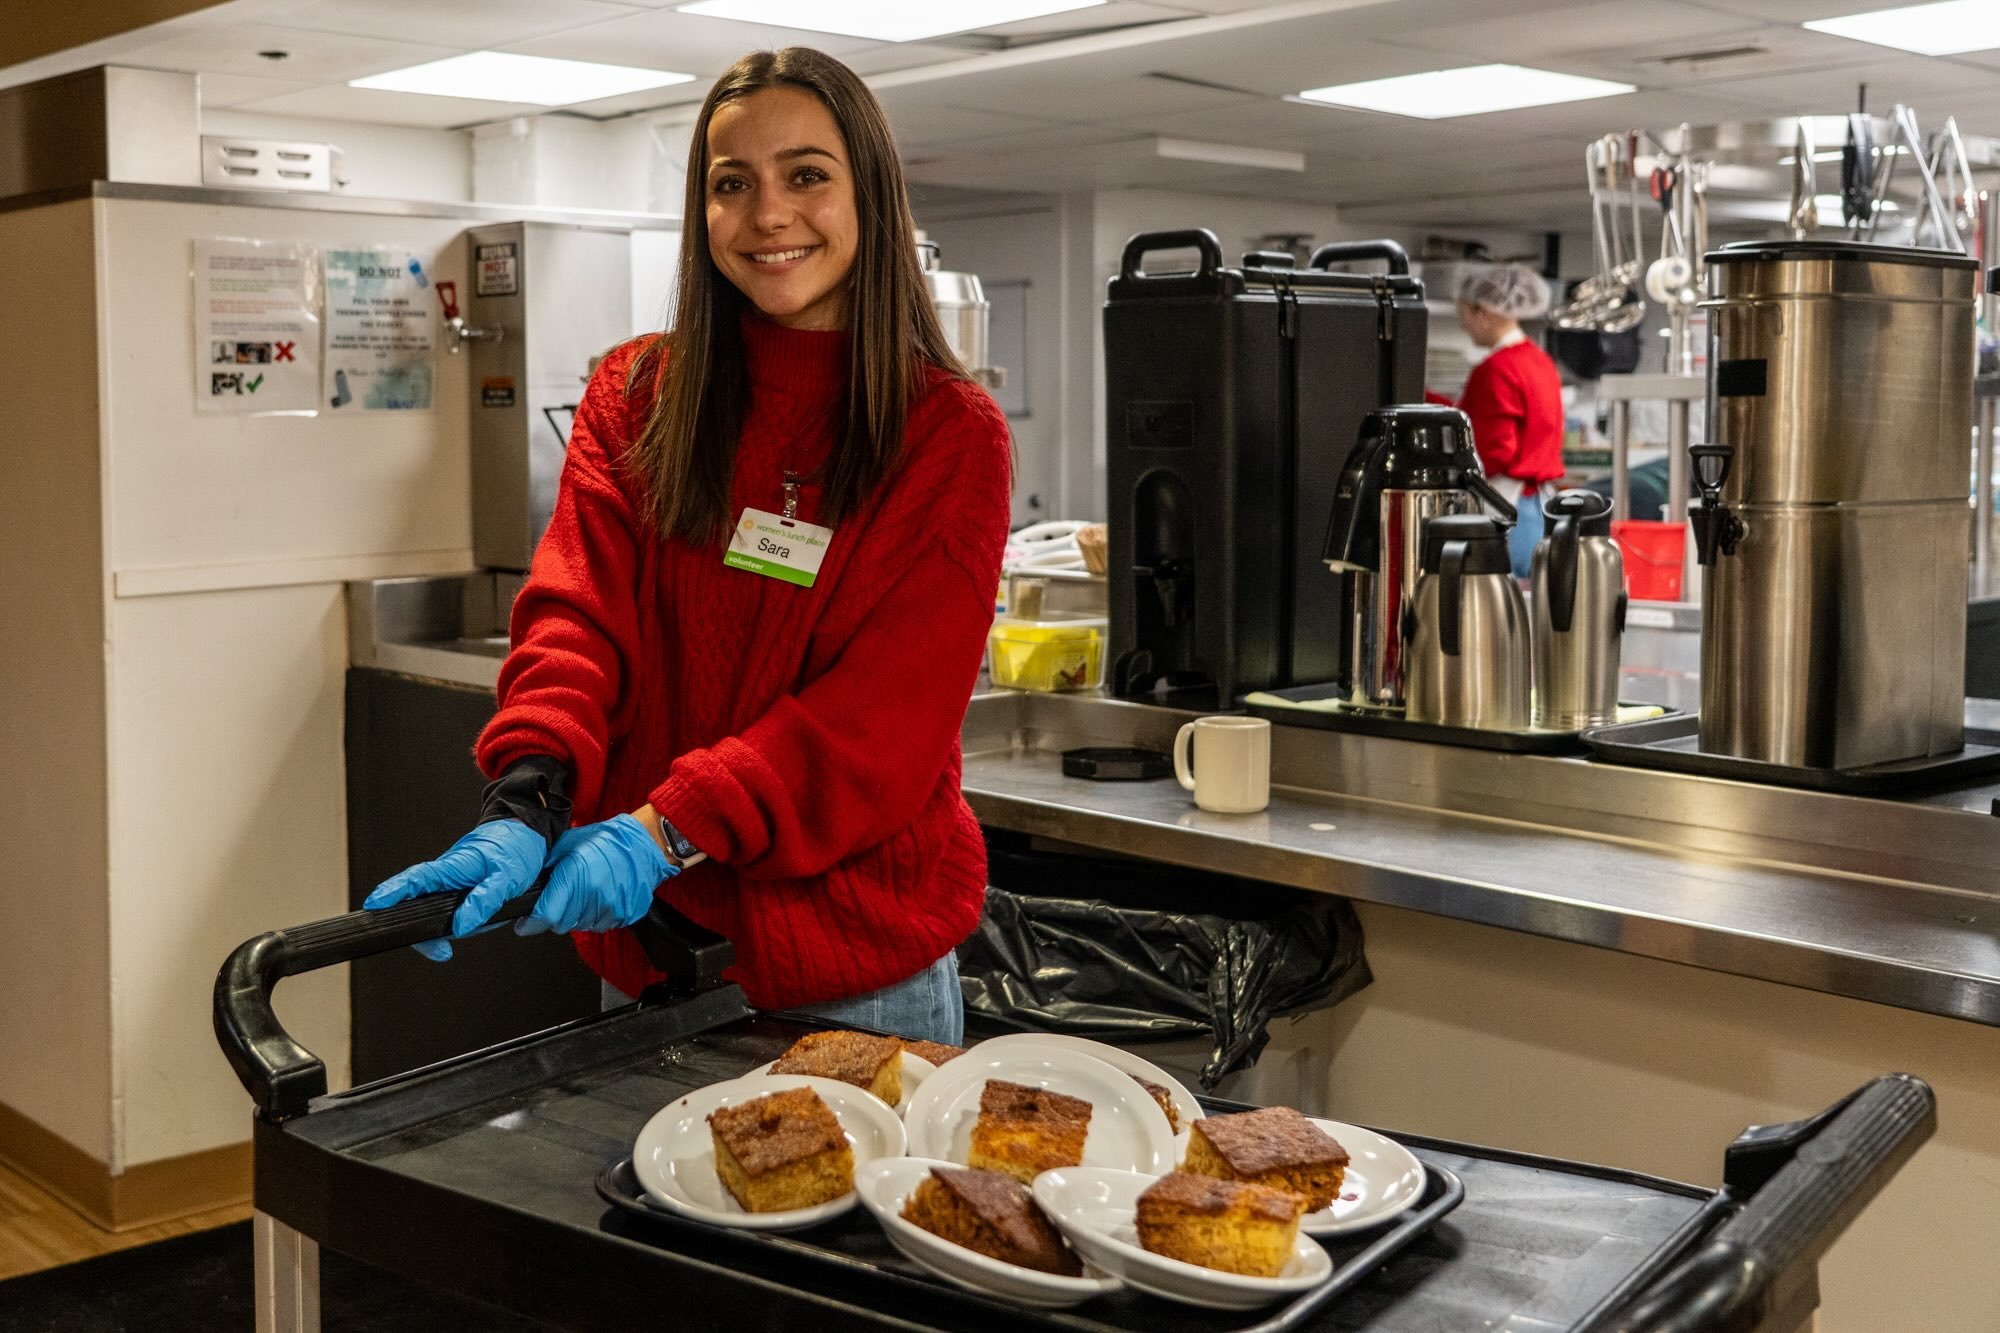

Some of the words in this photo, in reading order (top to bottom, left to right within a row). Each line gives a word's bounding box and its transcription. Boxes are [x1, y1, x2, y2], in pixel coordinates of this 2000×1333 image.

[359, 266, 376, 278] DO
[379, 266, 401, 279] NOT
[485, 260, 508, 272] HOT
[756, 524, 787, 537] women's
[786, 531, 806, 543] lunch
[806, 535, 826, 548] place
[758, 537, 790, 558] Sara
[728, 555, 764, 570] volunteer
